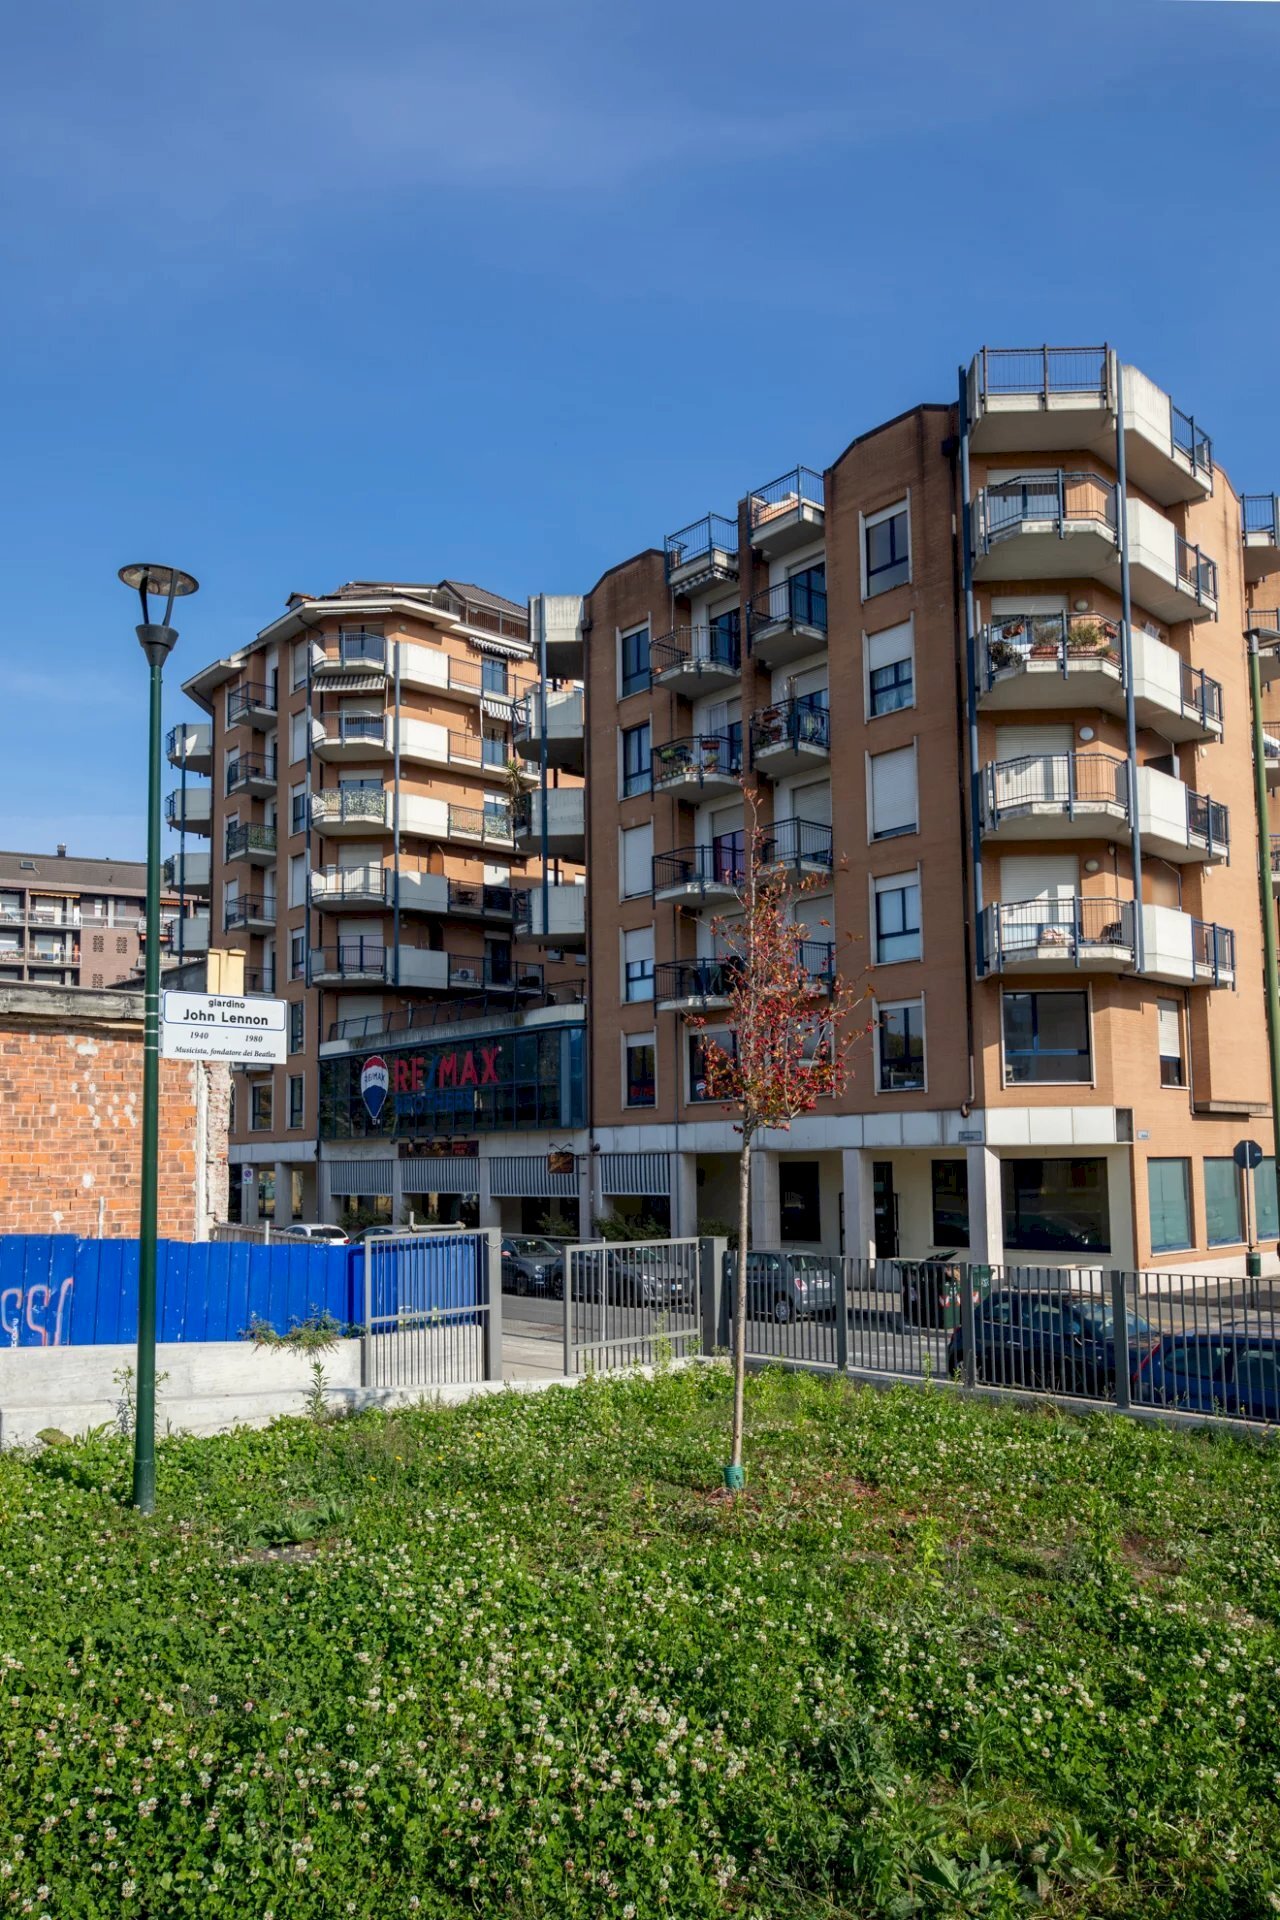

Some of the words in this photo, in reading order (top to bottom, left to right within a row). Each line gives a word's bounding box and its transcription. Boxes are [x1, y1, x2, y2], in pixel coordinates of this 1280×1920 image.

[208, 998, 245, 1009] giardino
[183, 1009, 215, 1022] John
[221, 1011, 268, 1026] Lennon
[190, 1031, 209, 1040] 1940
[245, 1034, 263, 1043] 1980
[174, 1046, 209, 1055] Musicista,
[209, 1048, 241, 1057] fondatore
[243, 1049, 253, 1057] dei
[254, 1050, 276, 1058] Beatles
[393, 1047, 499, 1093] RE/MAX
[395, 1090, 474, 1115] BROTHERS
